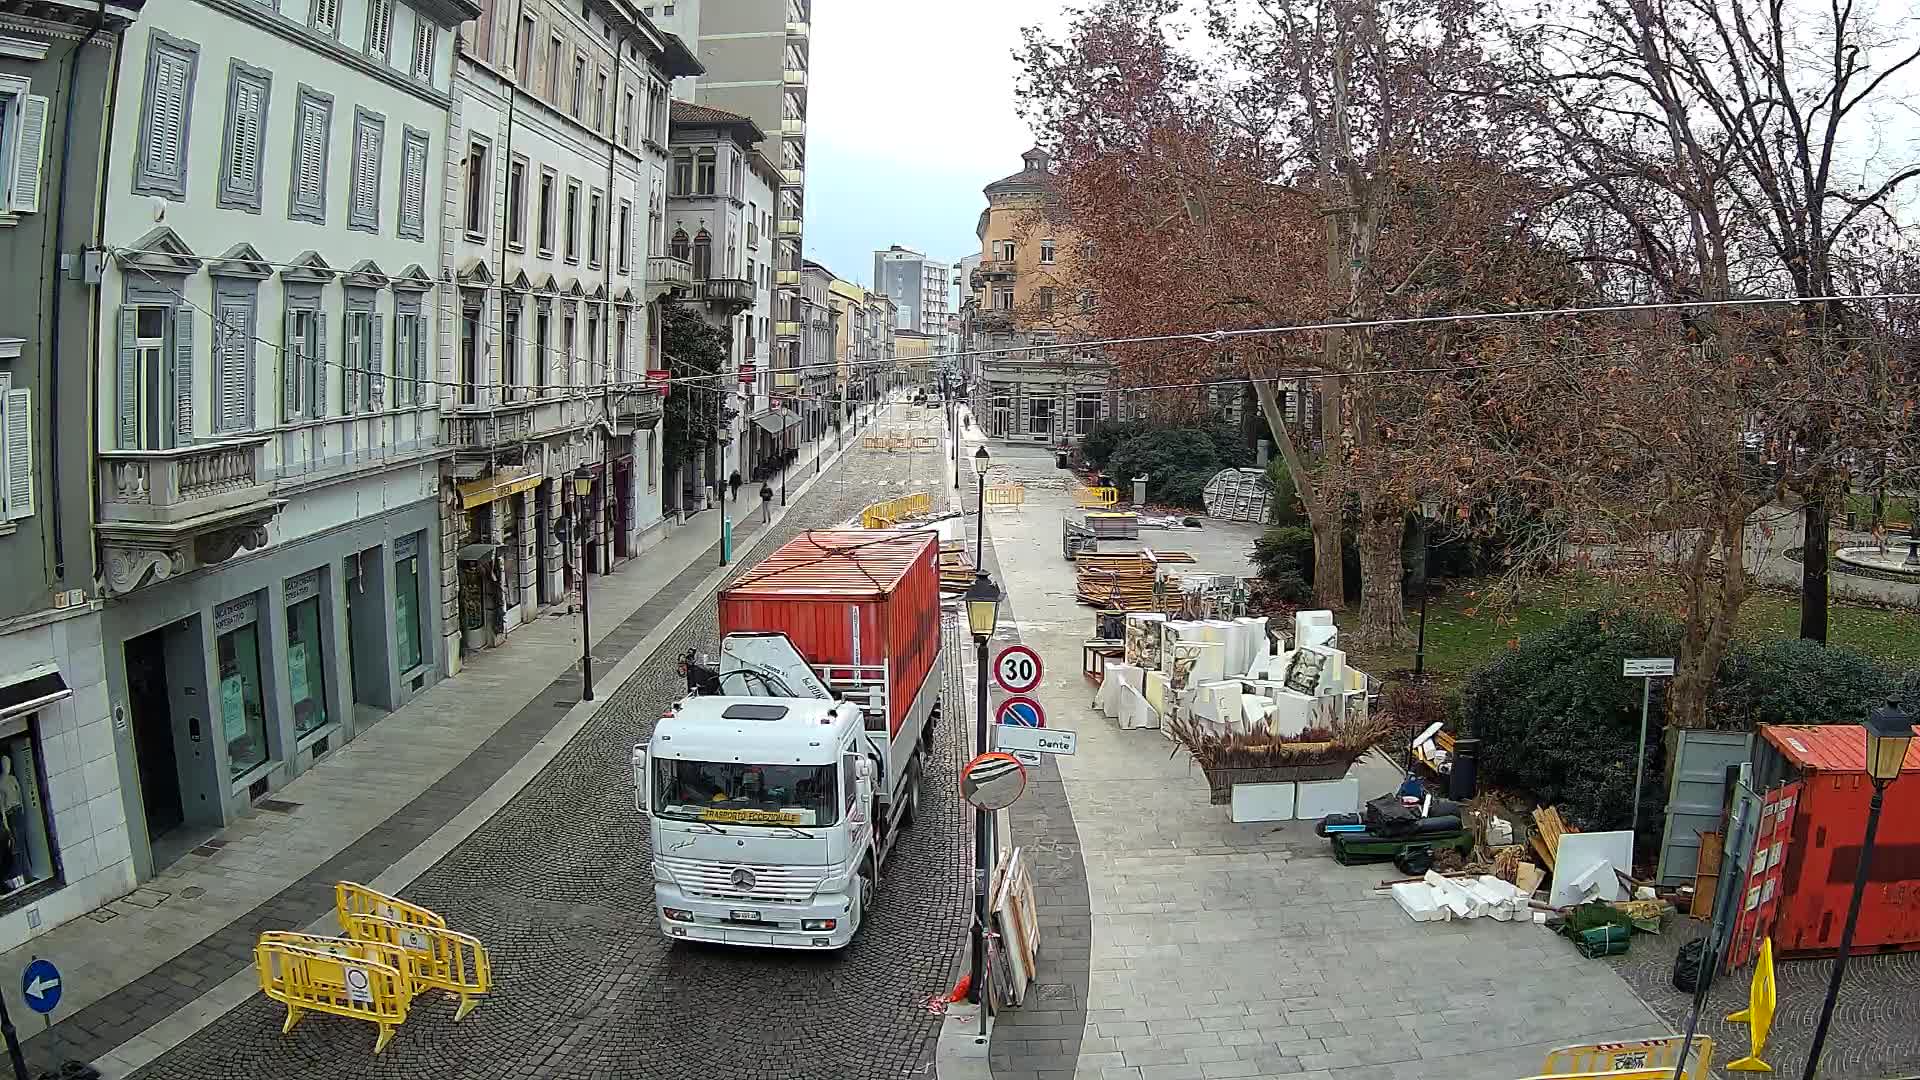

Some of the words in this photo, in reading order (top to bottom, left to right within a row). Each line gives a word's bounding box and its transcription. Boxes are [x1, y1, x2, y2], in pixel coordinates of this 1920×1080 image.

[1005, 659, 1032, 681] 30
[1038, 738, 1070, 750] Dante
[705, 809, 745, 821] TRASPORTO
[748, 811, 797, 823] ECCEZIONALE
